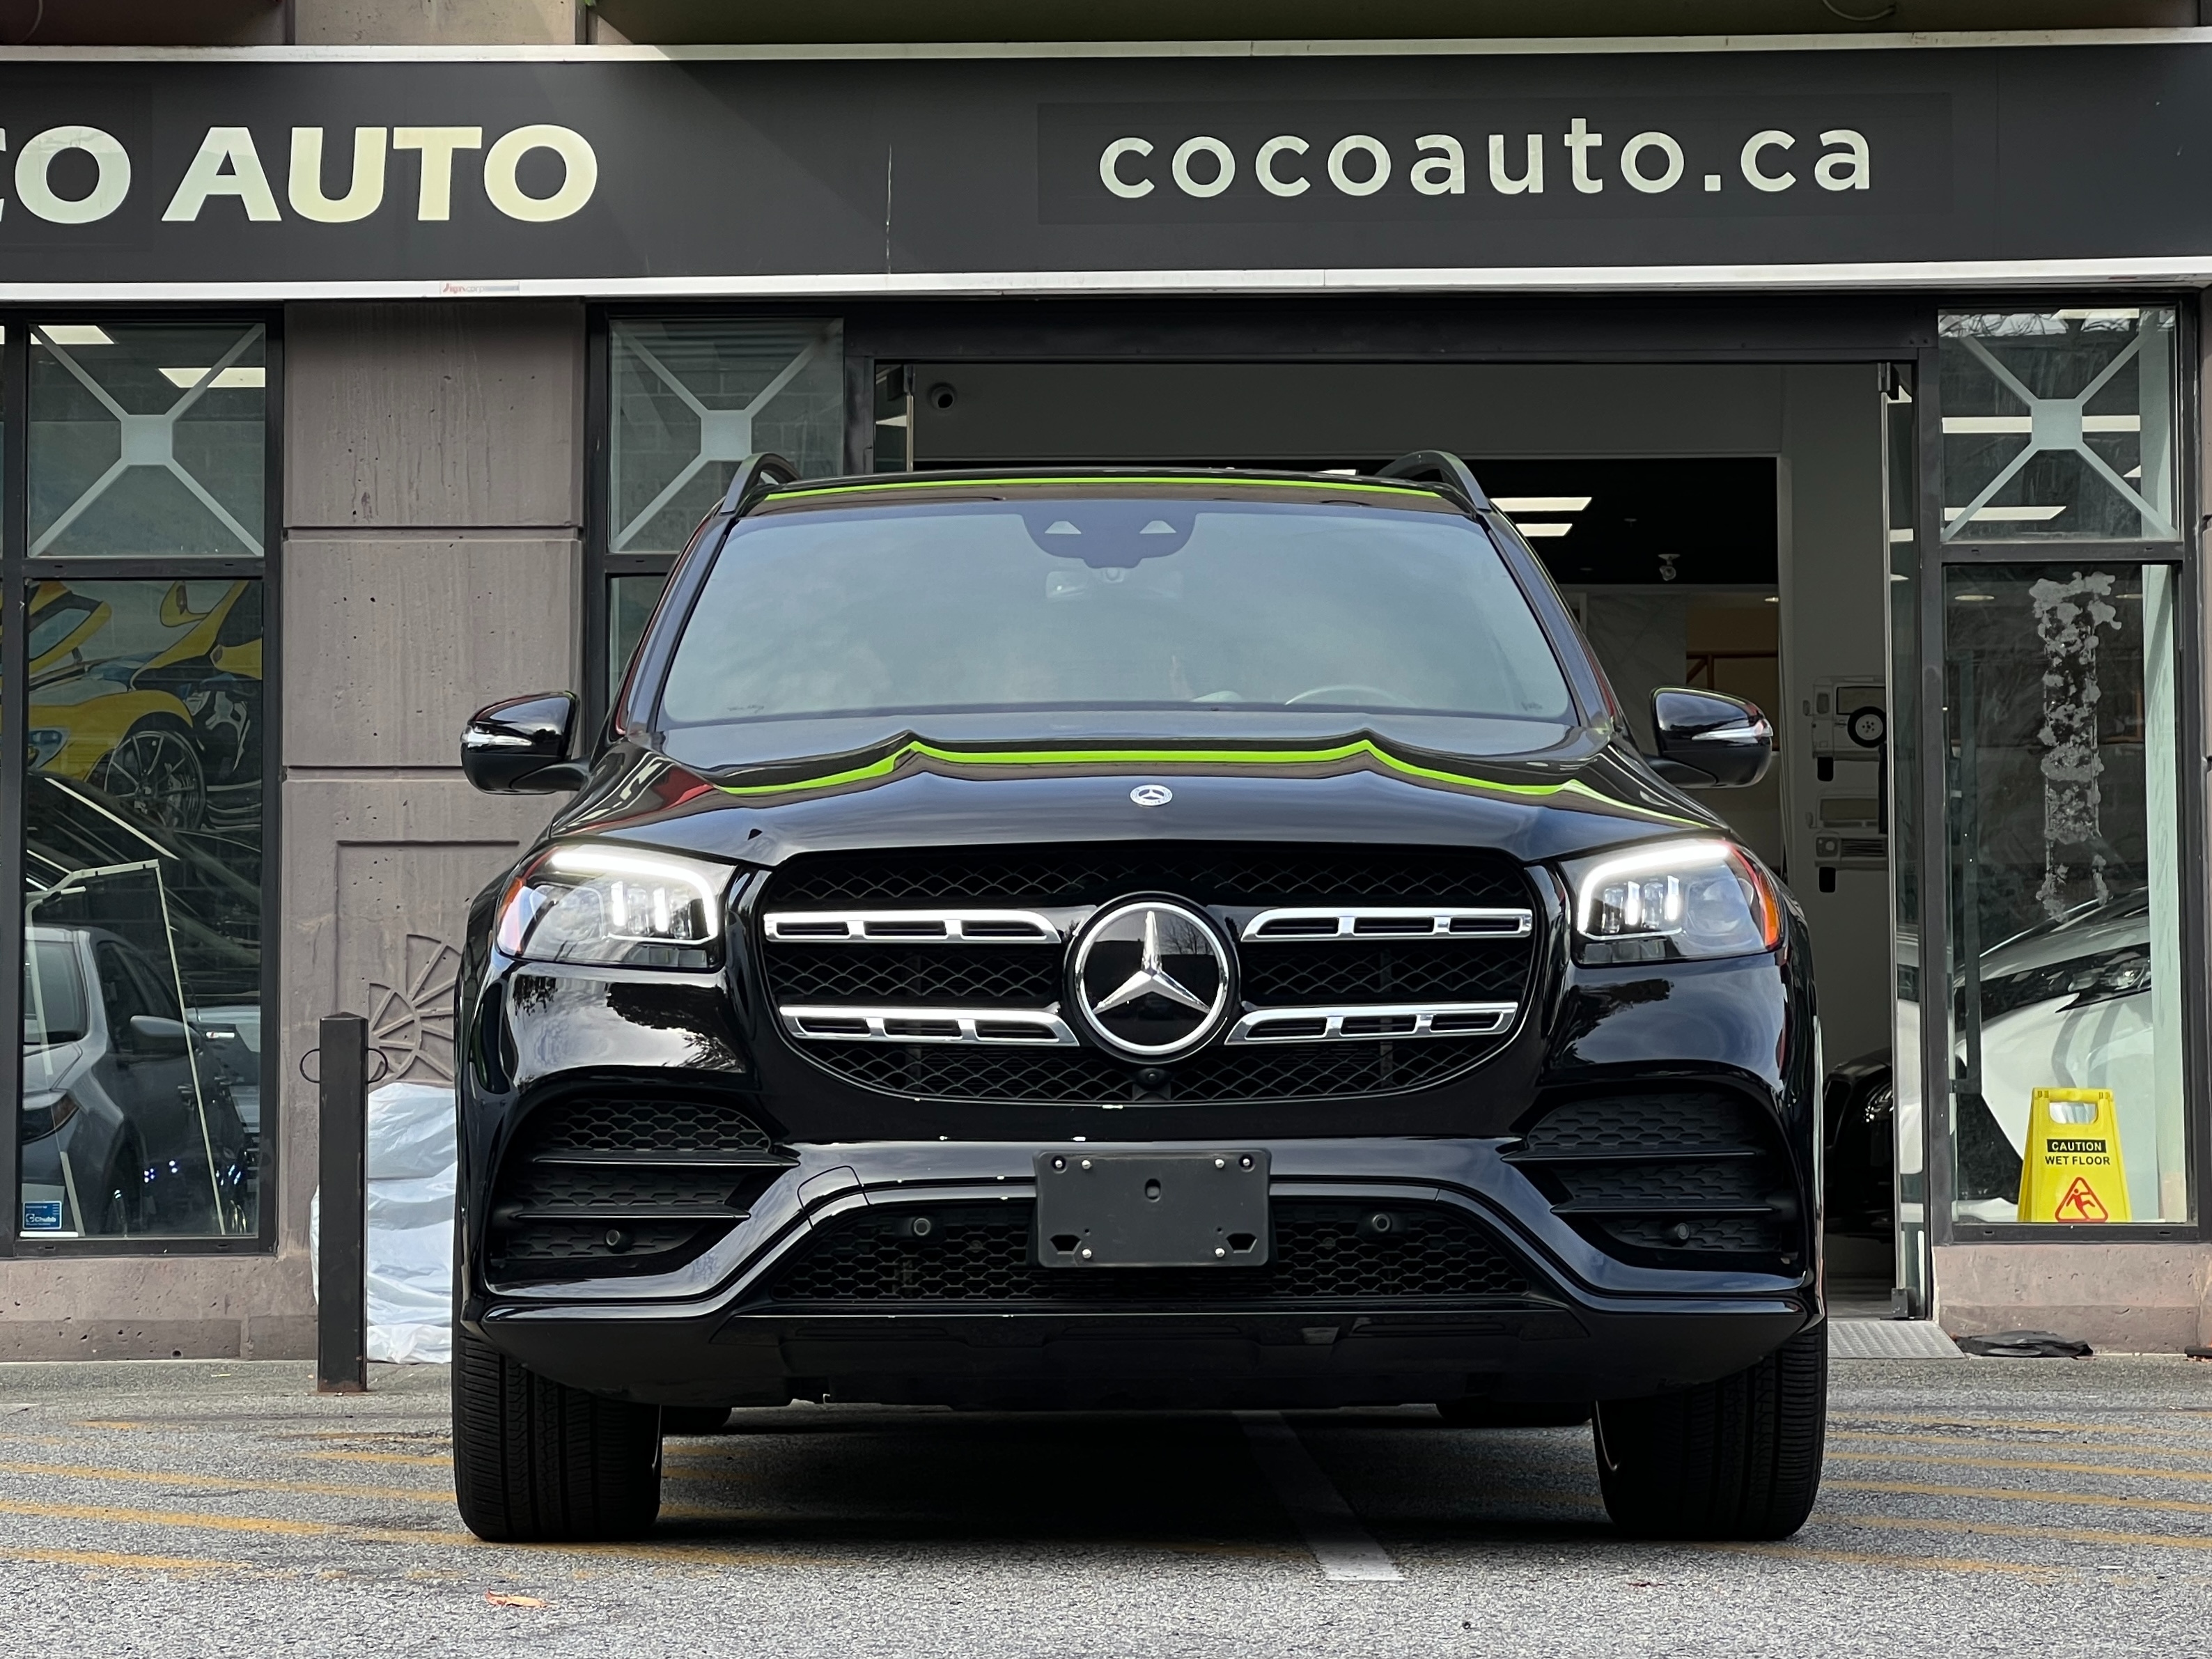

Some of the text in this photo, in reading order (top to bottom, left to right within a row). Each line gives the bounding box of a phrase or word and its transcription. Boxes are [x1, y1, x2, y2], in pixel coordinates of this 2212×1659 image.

[0, 124, 598, 224] O AUTO
[1099, 118, 1870, 198] cocoauto.ca
[2045, 1155, 2110, 1165] WET FLOOR
[2051, 1142, 2102, 1151] CAUTION
